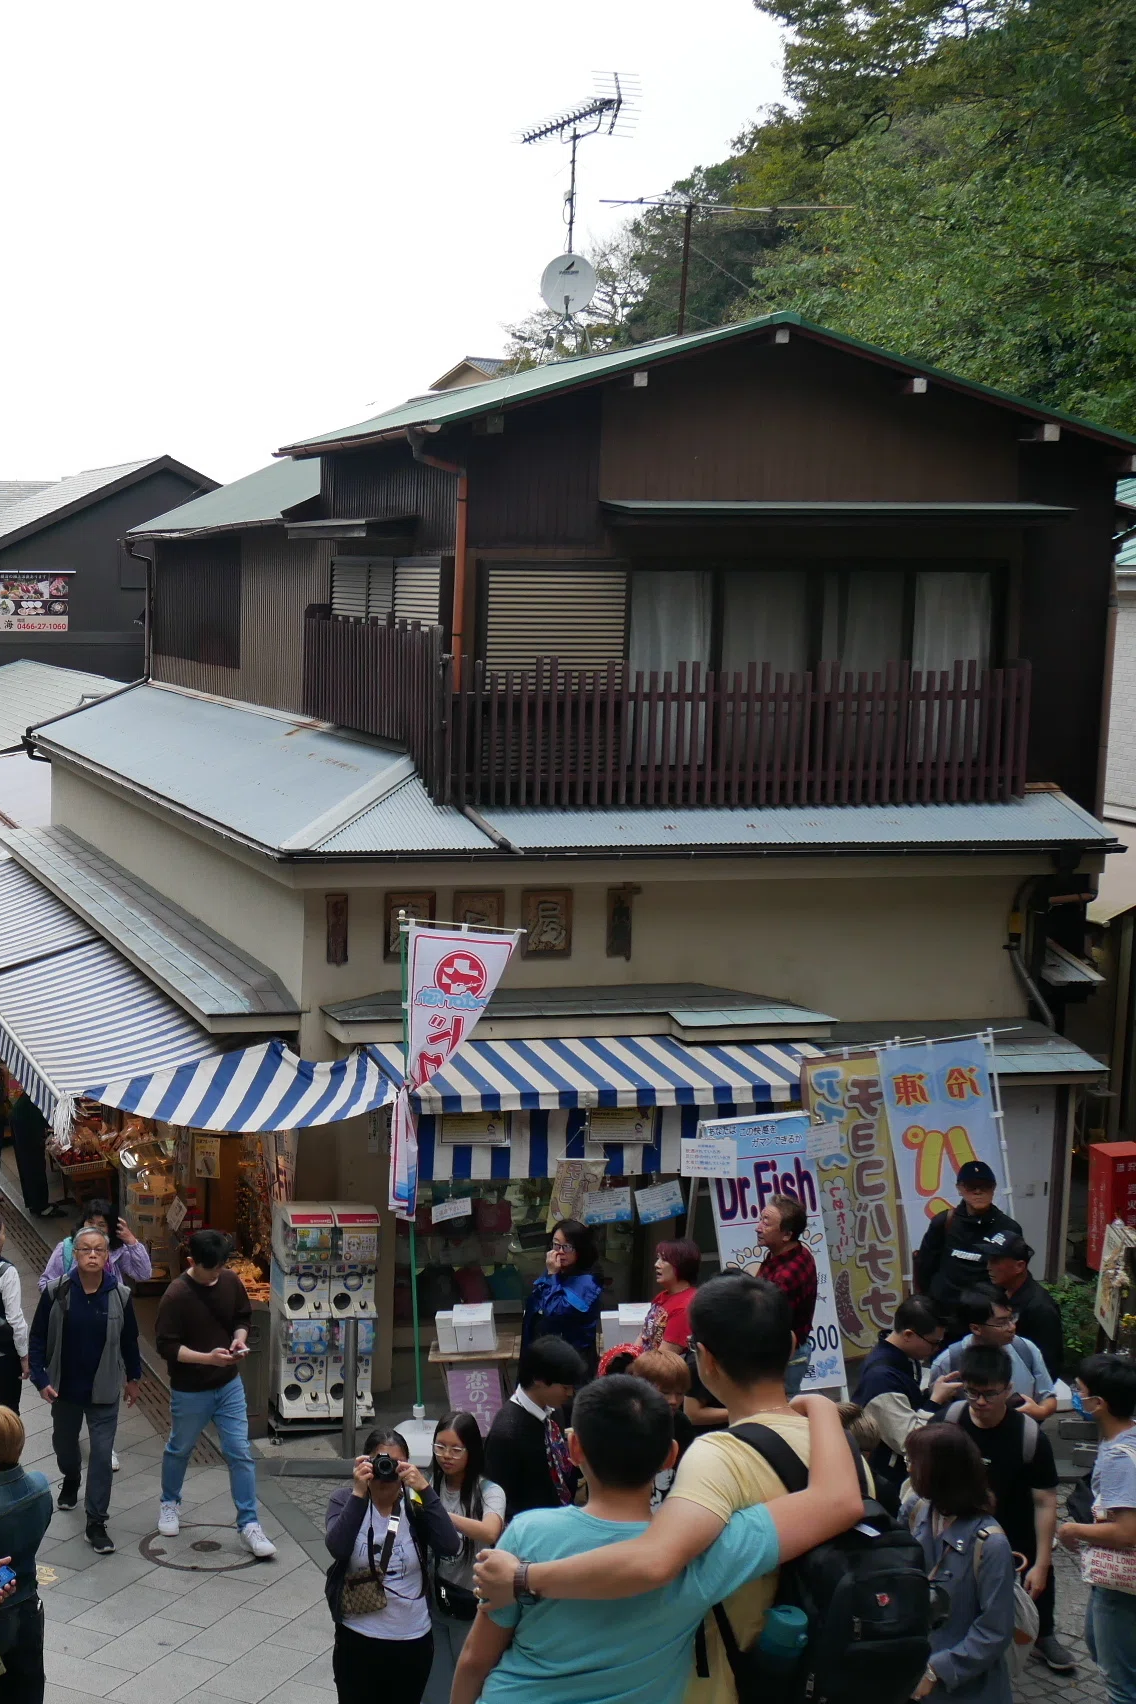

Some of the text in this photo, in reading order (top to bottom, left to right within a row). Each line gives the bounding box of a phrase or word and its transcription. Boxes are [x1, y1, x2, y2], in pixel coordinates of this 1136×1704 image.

[715, 1157, 817, 1221] Dr.Fish
[1093, 1551, 1114, 1562] TAIPEI
[1091, 1559, 1119, 1572] BEIJING
